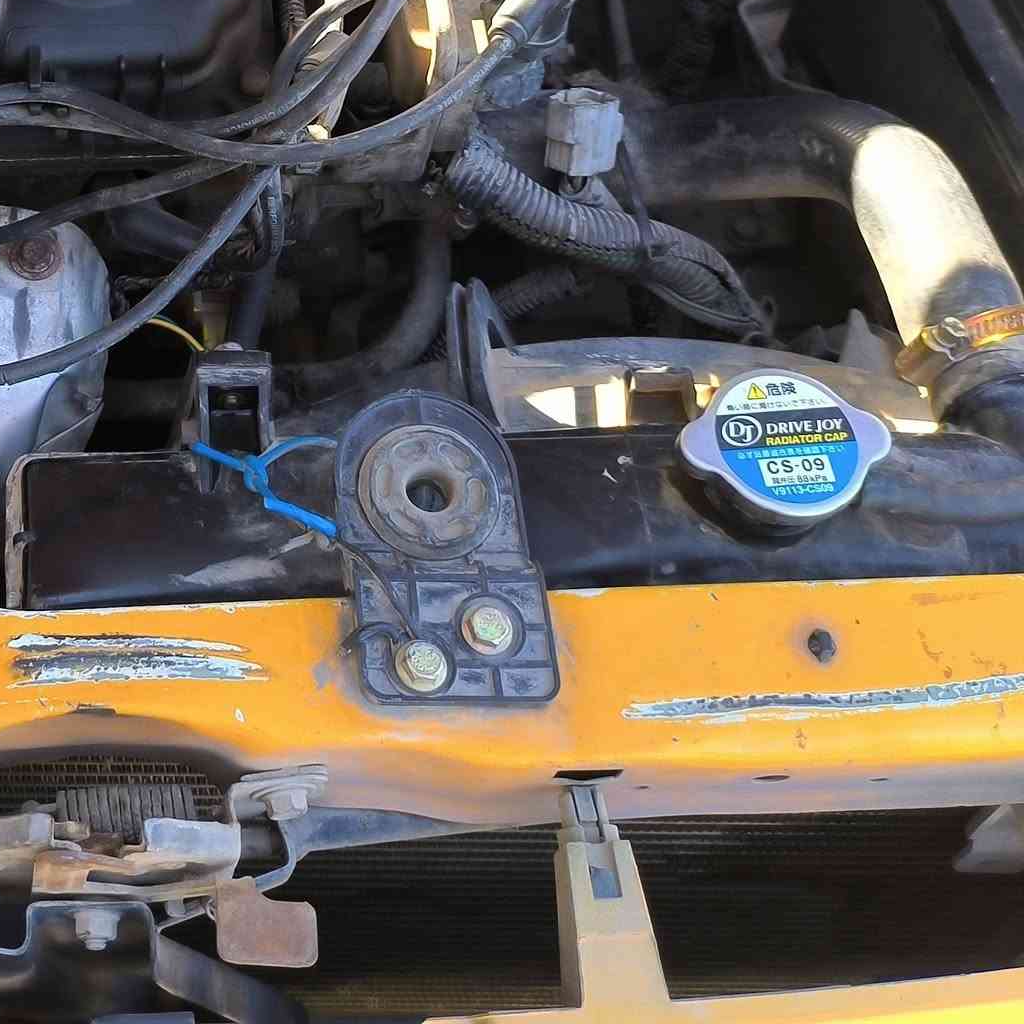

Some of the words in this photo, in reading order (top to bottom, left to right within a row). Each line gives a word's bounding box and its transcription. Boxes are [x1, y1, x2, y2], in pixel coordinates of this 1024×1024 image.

[767, 382, 797, 396] 危険
[729, 421, 755, 442] DJ
[766, 420, 816, 435] DRIVE
[817, 418, 844, 433] JOY
[766, 433, 823, 446] RADIATOR
[824, 431, 849, 442] CAP
[767, 458, 825, 475] CS-09
[772, 483, 834, 497] V9113-CS09
